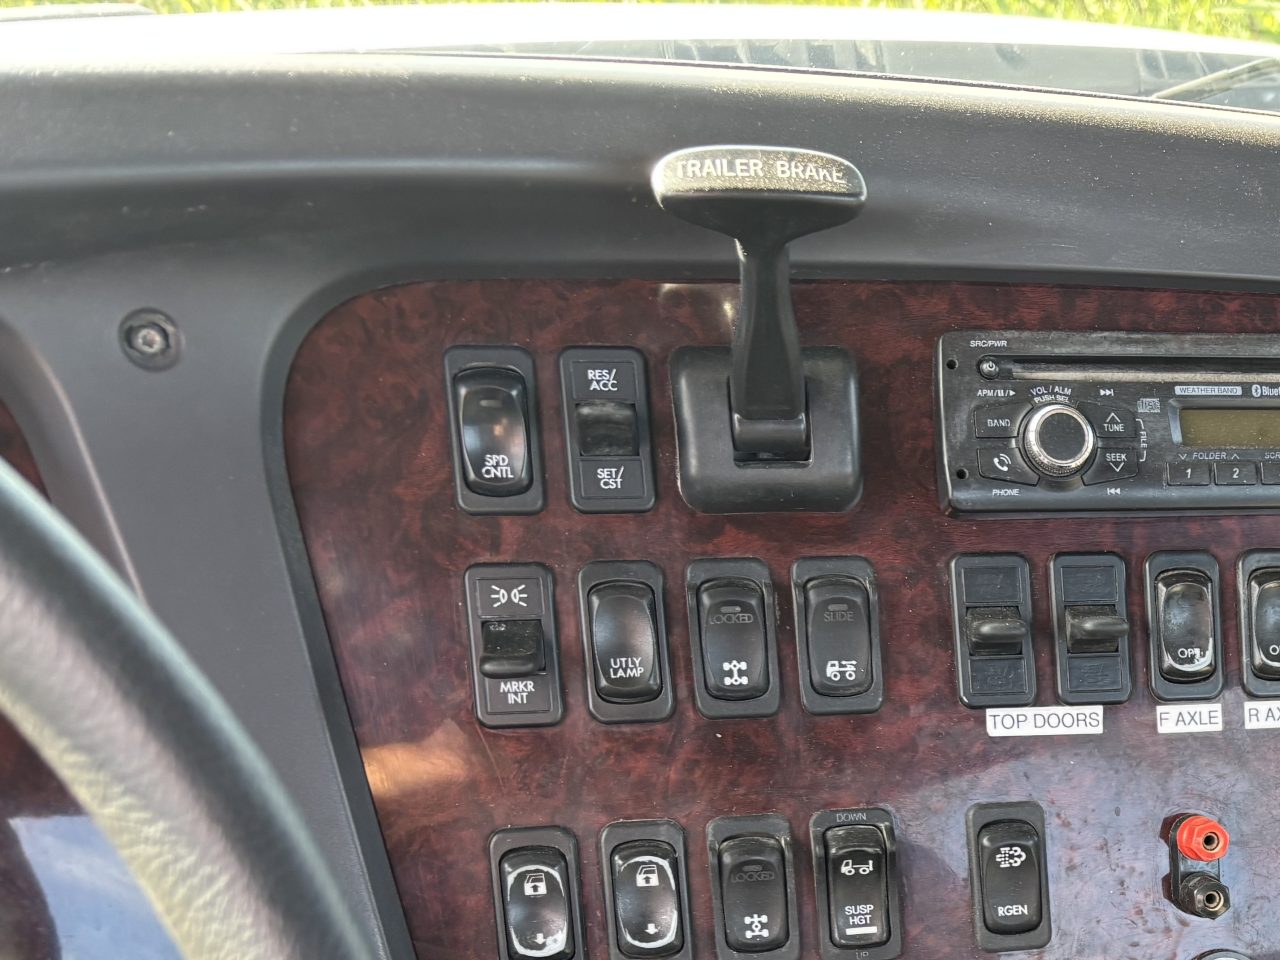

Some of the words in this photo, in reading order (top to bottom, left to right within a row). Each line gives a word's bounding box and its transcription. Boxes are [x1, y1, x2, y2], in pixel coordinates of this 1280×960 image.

[675, 158, 764, 178] TRAILER
[776, 160, 848, 184] BRAKE
[969, 340, 1008, 348] SRC/PWR
[587, 368, 617, 384] RES/
[590, 380, 618, 392] ACC
[1030, 386, 1048, 396] VOL
[1054, 385, 1072, 396] ALM
[1179, 387, 1216, 395] WEATHER
[1217, 387, 1239, 395] BAND
[1033, 395, 1055, 404] PUSH
[987, 417, 1011, 428] BAND
[1103, 424, 1126, 433] TUNE
[1139, 431, 1148, 449] FILE
[484, 455, 509, 466] SPD
[1106, 453, 1128, 463] SEEK
[1192, 452, 1227, 461] FOLDER
[481, 466, 515, 479] CNTL
[597, 465, 625, 480] SET/
[1185, 468, 1192, 479] 1
[1232, 467, 1240, 479] 2
[600, 476, 623, 489] CST
[992, 487, 1020, 497] PHONE
[709, 613, 754, 625] LOCKED
[823, 611, 855, 622] SLIDE
[610, 657, 643, 668] UTLY
[610, 667, 645, 679] LAMP
[500, 681, 535, 693] MRKR
[507, 692, 528, 705] INT
[989, 713, 1028, 730] TOP
[1033, 711, 1100, 729] DOORS
[1159, 712, 1169, 727] F
[1174, 710, 1220, 726] AXLE
[1248, 708, 1260, 723] R
[836, 812, 868, 823] DOWN
[731, 871, 776, 883] LOCKED
[844, 904, 875, 915] SUSP
[998, 904, 1028, 917] RGEN
[849, 914, 872, 925] HGT
